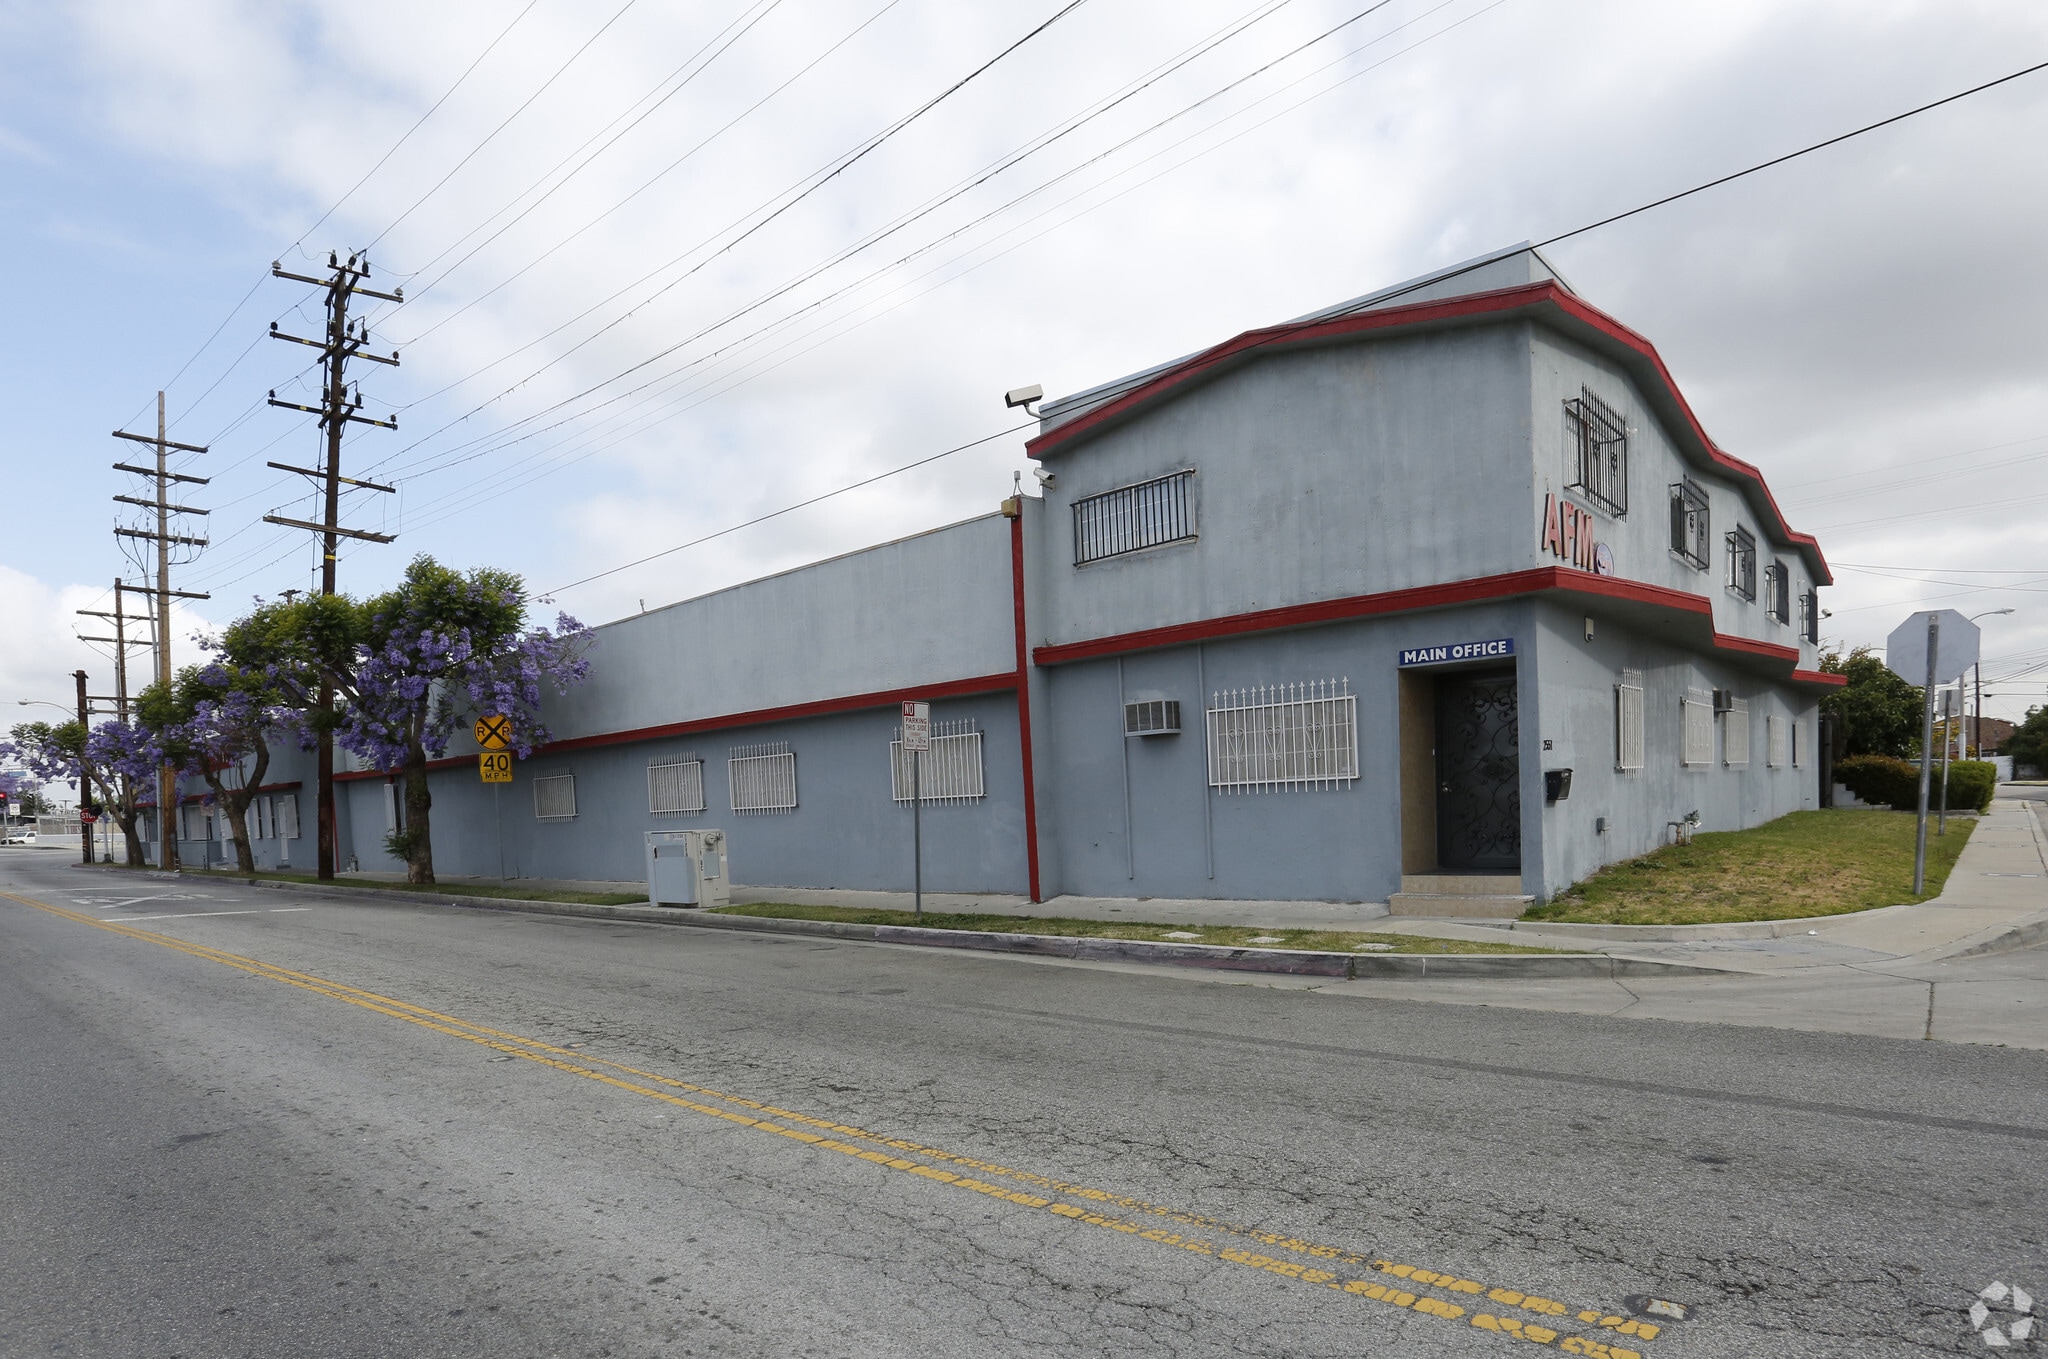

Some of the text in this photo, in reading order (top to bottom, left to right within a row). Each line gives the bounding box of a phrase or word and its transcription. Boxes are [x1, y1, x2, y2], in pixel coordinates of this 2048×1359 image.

[1542, 493, 1594, 571] AFM
[1404, 641, 1506, 663] MAIN OFFICE
[904, 703, 914, 715] NO
[477, 727, 485, 736] R
[483, 755, 508, 771] 40
